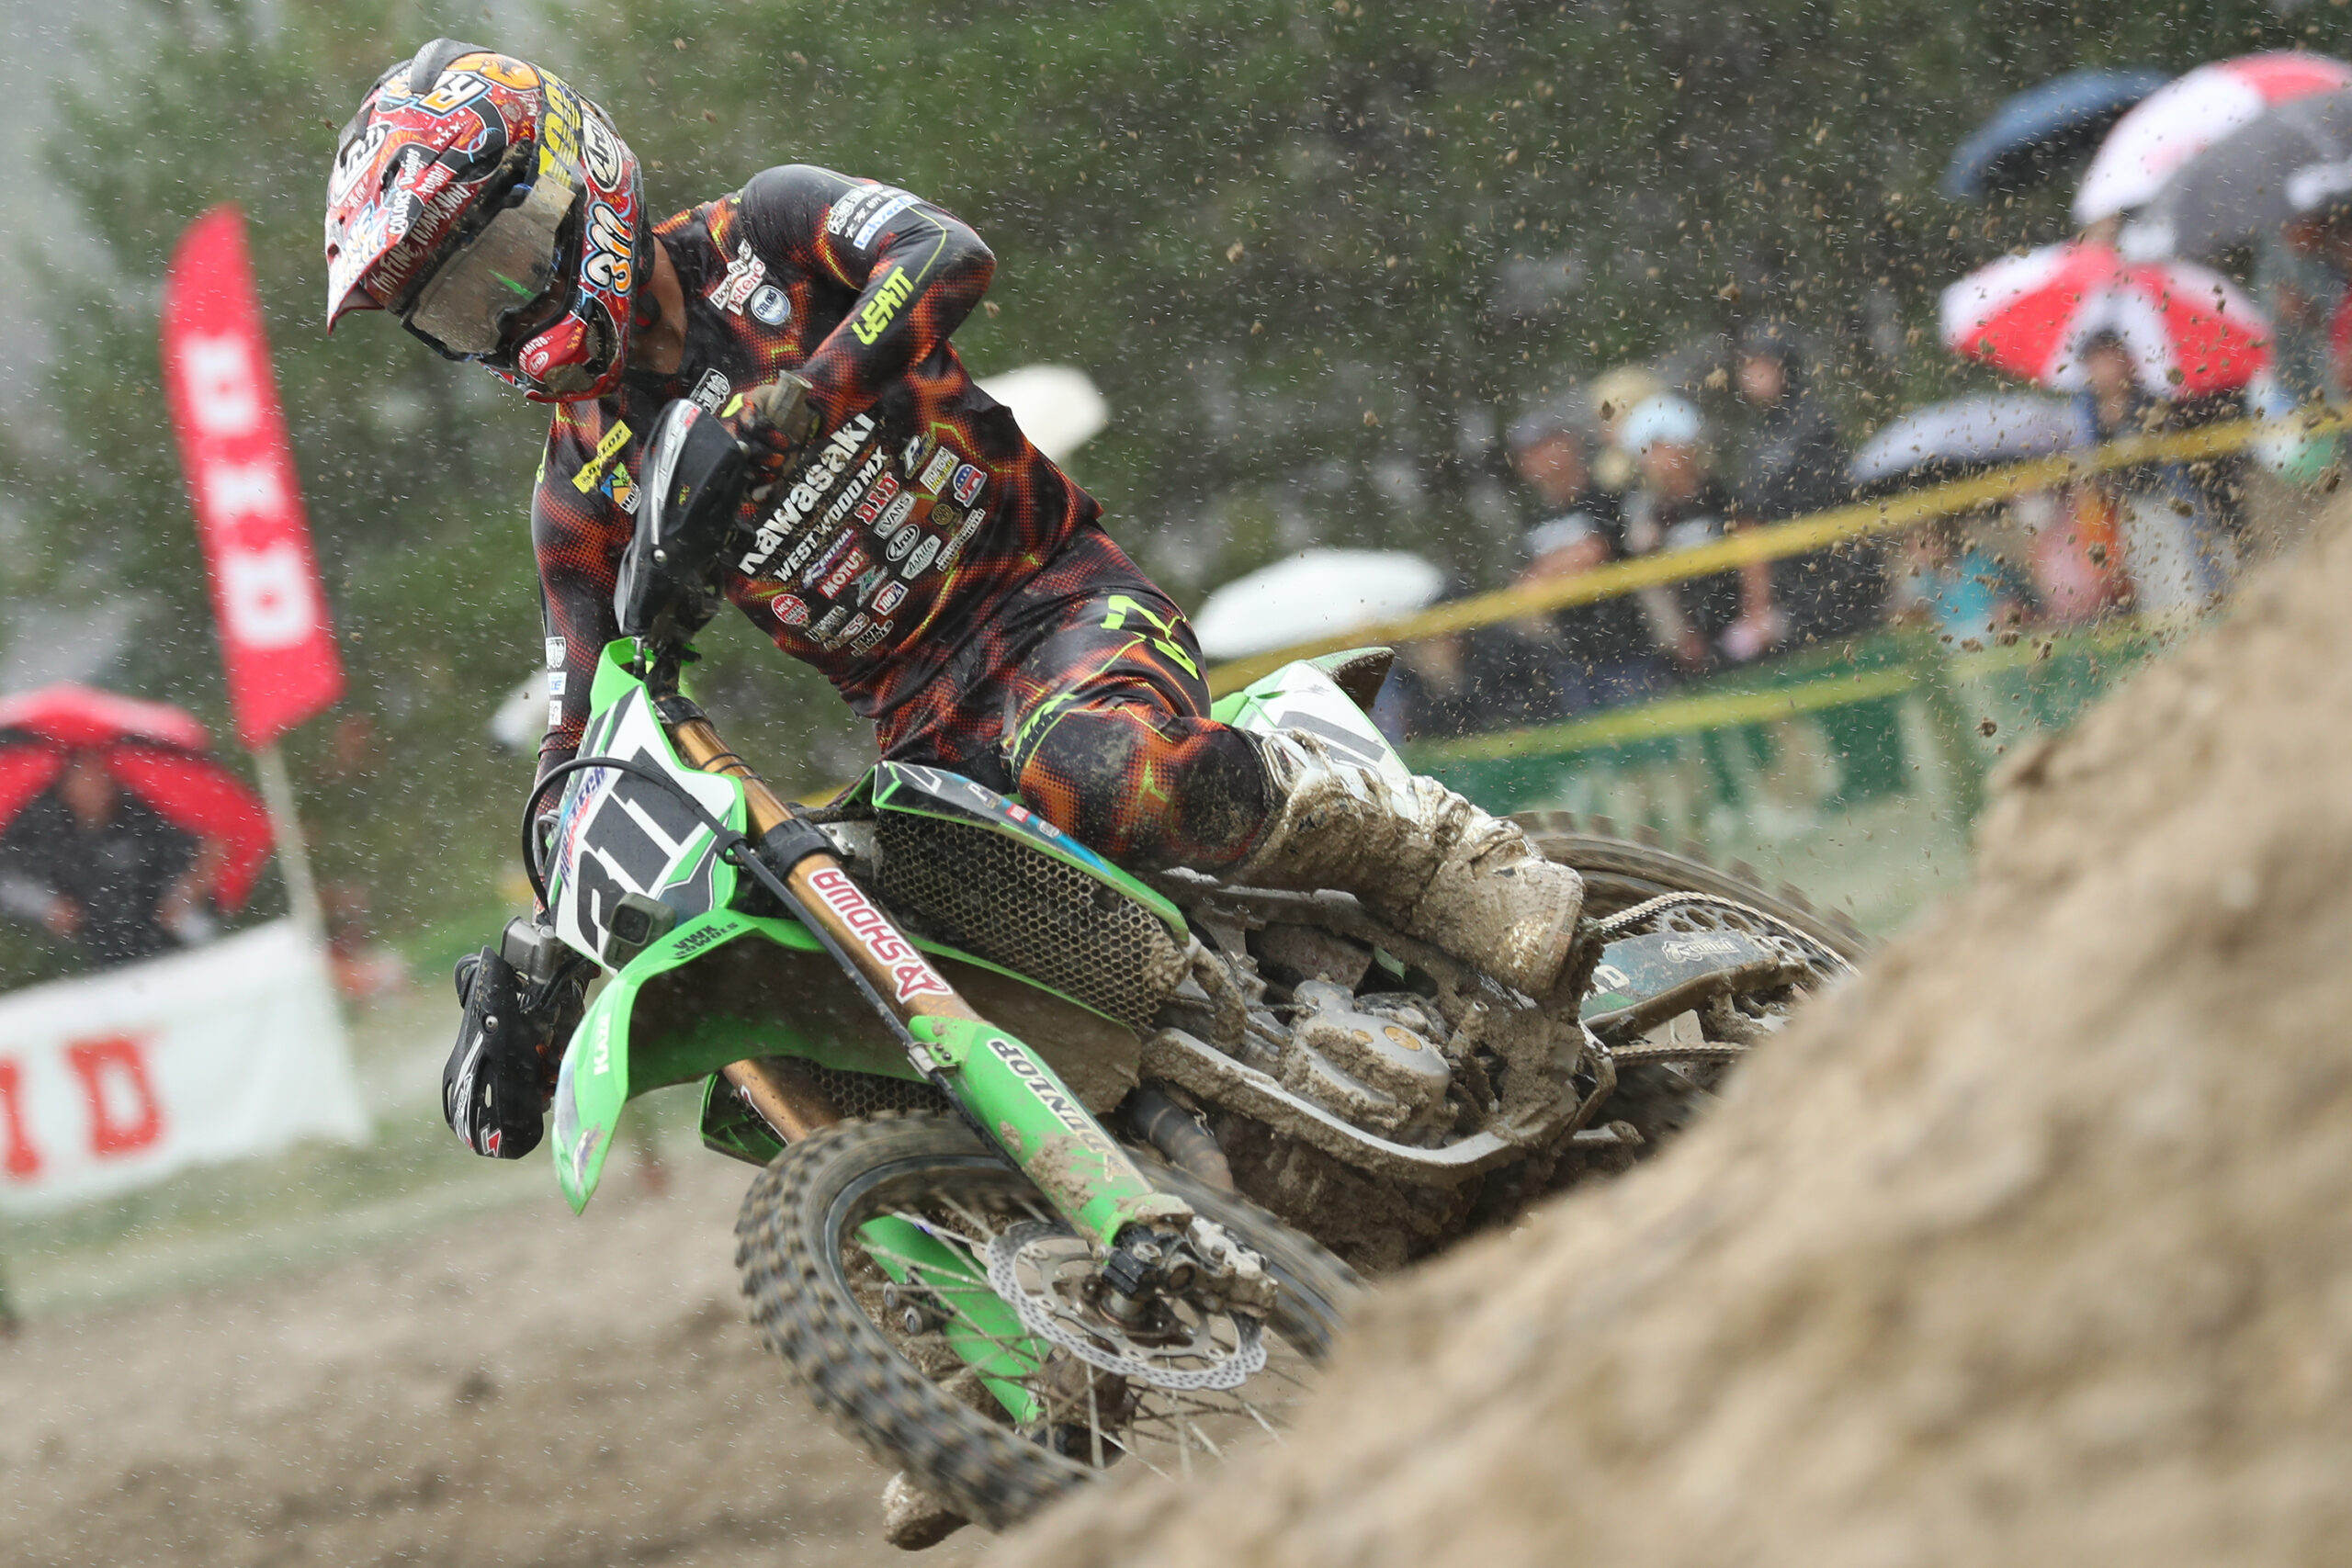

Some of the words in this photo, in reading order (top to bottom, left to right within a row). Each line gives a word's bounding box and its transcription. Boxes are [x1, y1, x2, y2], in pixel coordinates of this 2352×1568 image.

[387, 186, 413, 235] COLORS
[851, 265, 914, 345] LEATT
[879, 496, 912, 533] EVANS
[891, 526, 916, 557] Arai
[879, 583, 903, 609] 100%
[810, 870, 911, 964] SHOWA
